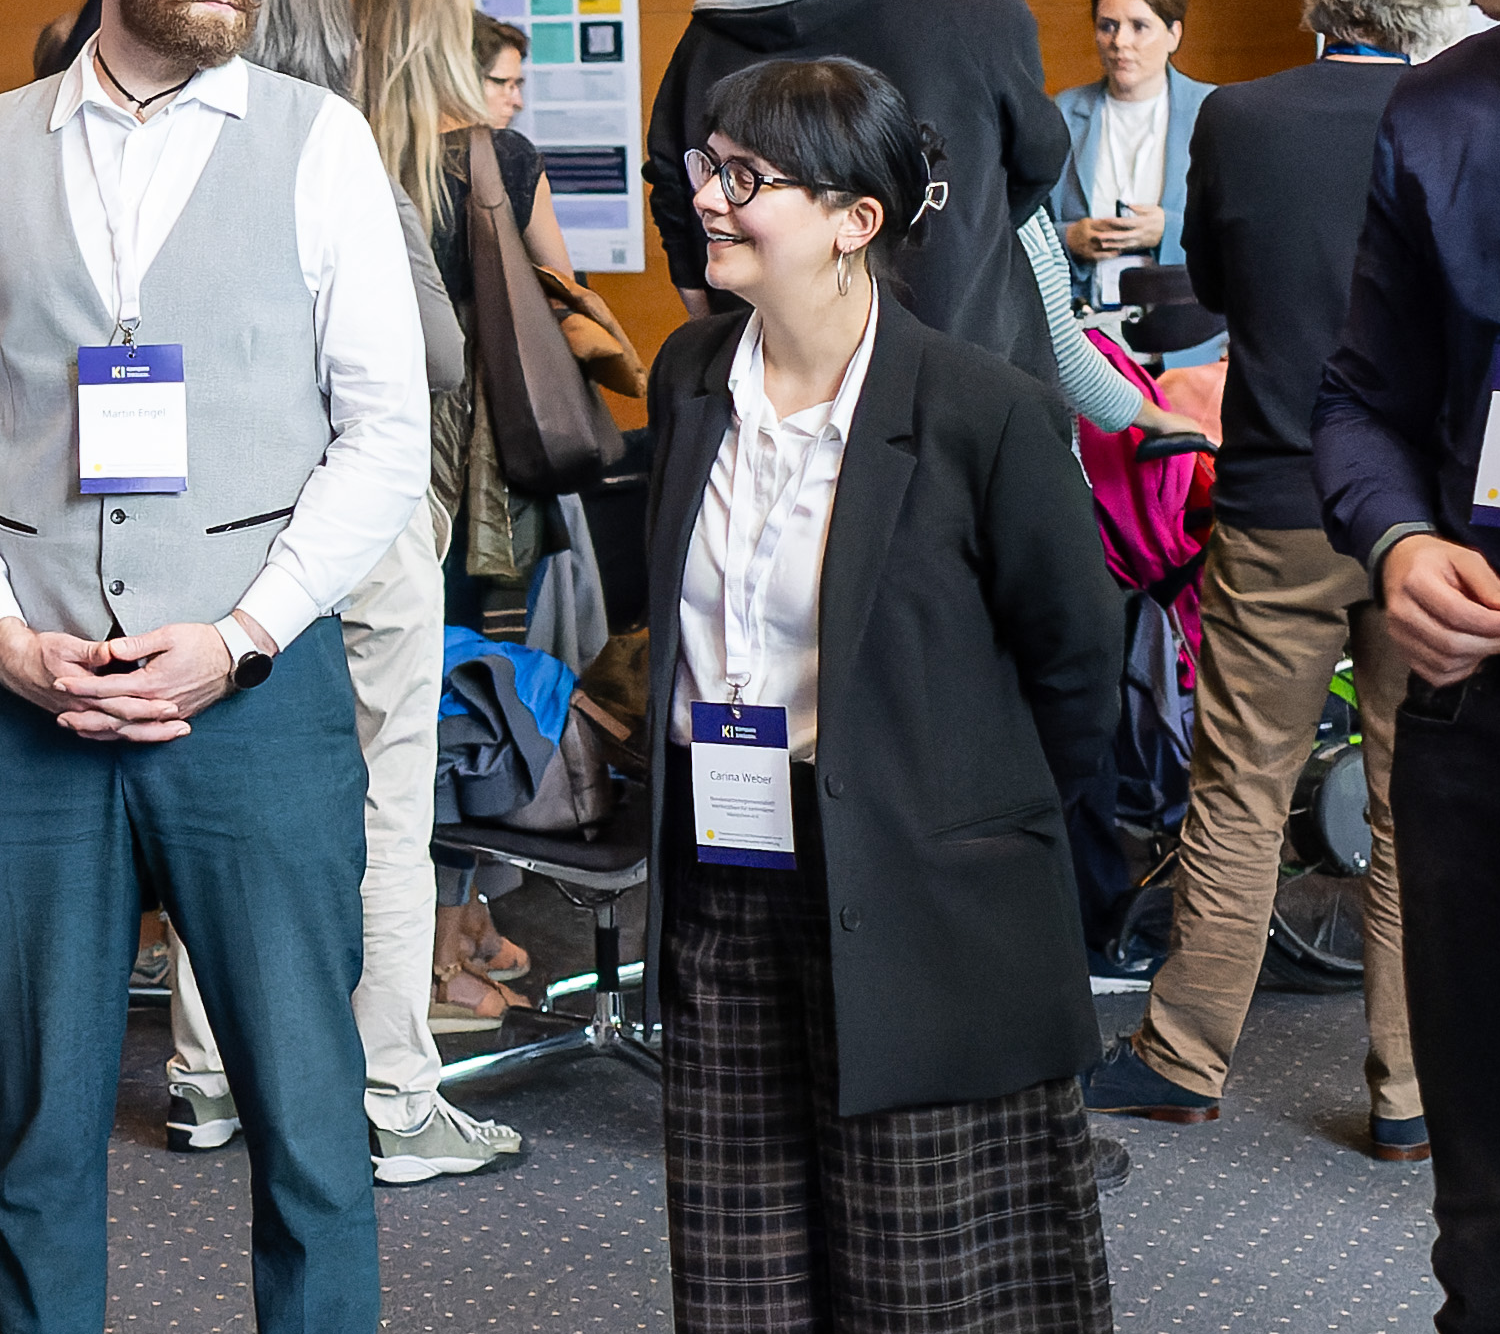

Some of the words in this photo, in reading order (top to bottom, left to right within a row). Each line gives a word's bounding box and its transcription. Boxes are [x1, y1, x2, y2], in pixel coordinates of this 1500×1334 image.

[111, 366, 126, 378] KI
[103, 410, 135, 419] Martin
[138, 408, 166, 419] Engel
[721, 725, 734, 738] KI
[710, 770, 740, 782] Carina
[742, 772, 772, 784] Weber
